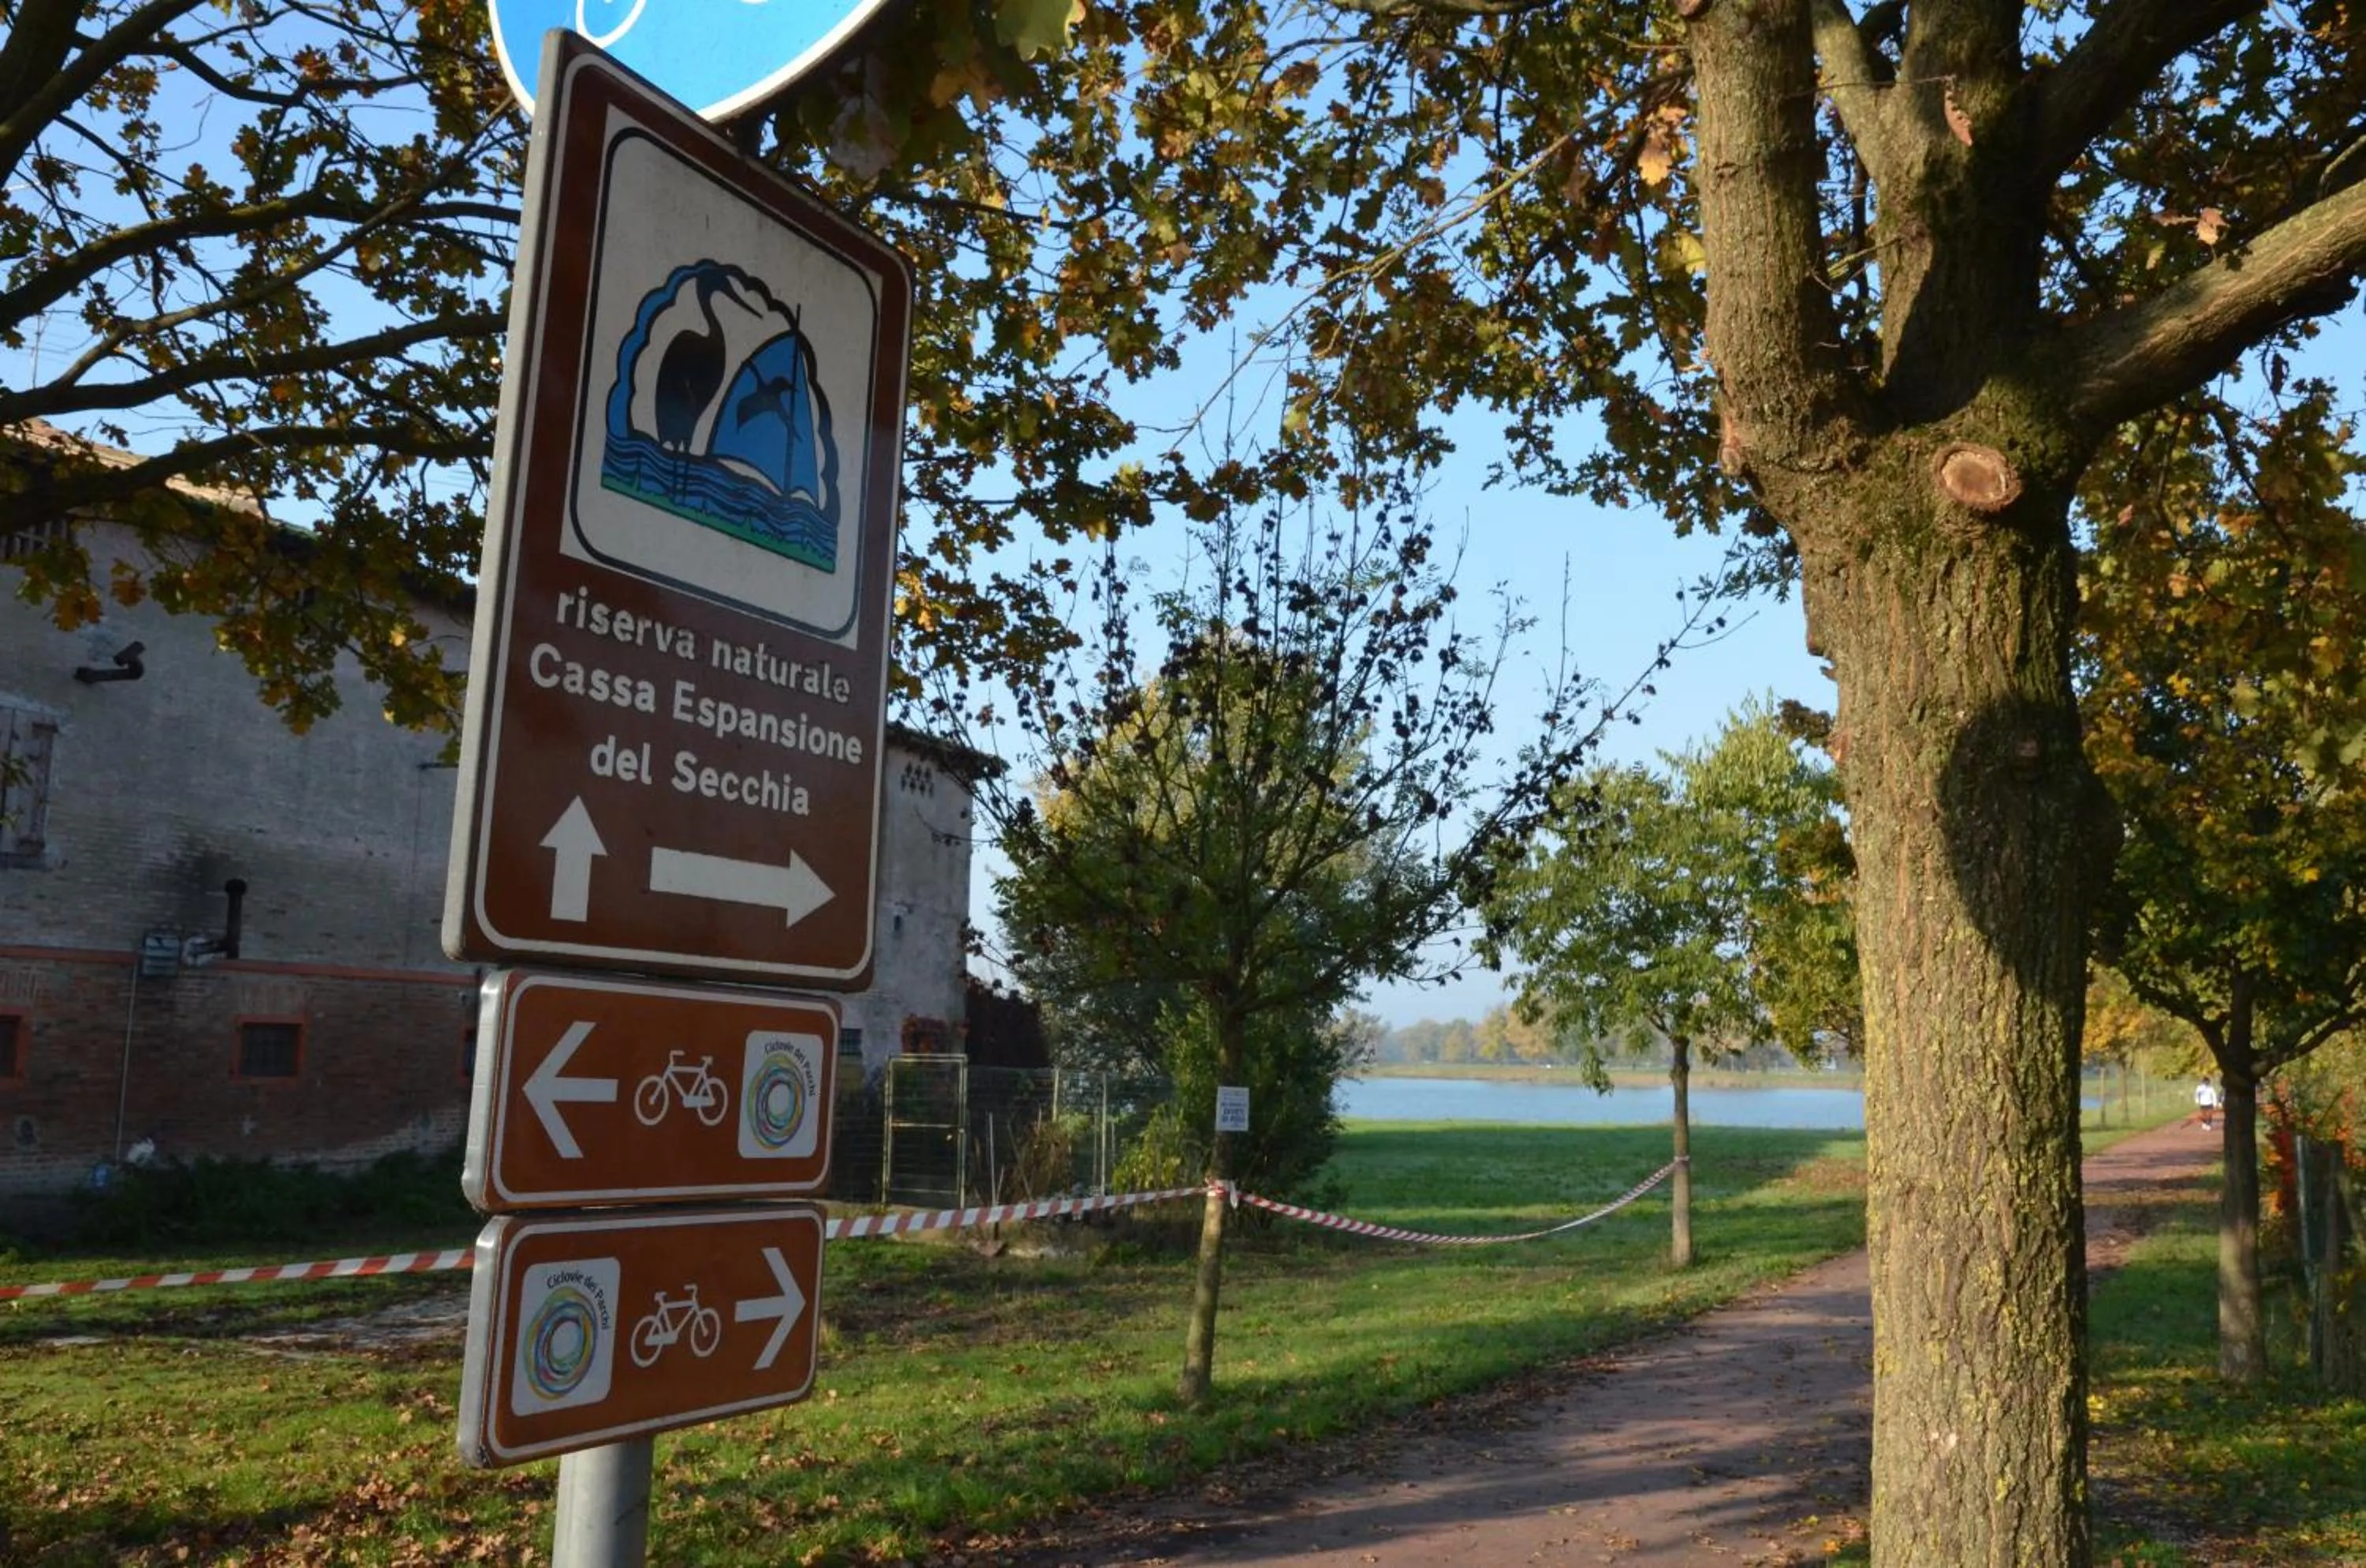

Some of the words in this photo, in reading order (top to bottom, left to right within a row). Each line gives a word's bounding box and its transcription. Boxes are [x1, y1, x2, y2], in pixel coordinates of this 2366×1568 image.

[529, 643, 656, 714] Cassa
[673, 680, 863, 764] Espansione
[555, 586, 695, 660] riserva
[711, 637, 850, 704] naturale
[590, 735, 652, 784] del
[671, 750, 811, 816] Secchia
